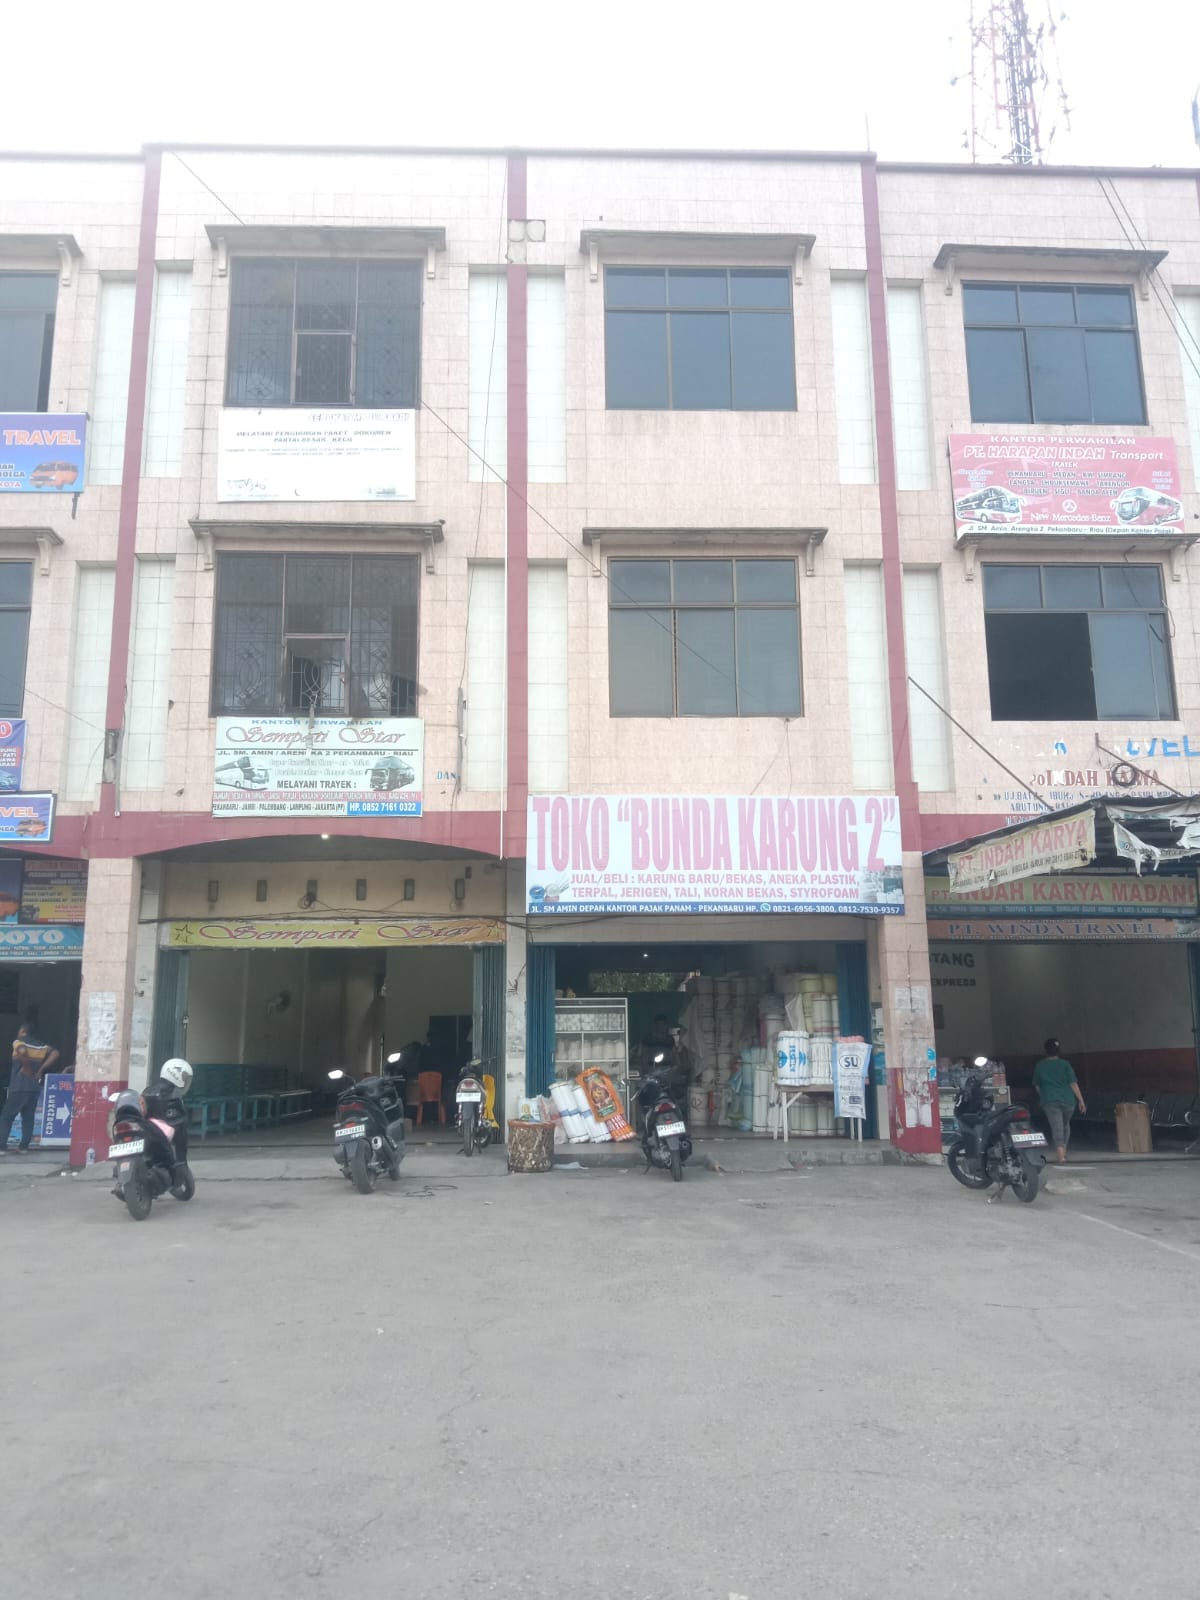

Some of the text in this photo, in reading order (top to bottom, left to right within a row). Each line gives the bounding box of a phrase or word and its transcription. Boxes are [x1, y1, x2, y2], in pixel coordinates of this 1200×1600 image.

[3, 429, 81, 446] TRAVEL
[990, 435, 1136, 445] KANTOR PERWAKILAN
[963, 445, 1164, 462] PT. HARAPAN INDAH Transport
[338, 726, 407, 744] Star
[277, 780, 318, 789] MELAYANI
[319, 780, 352, 789] TRAYEK
[349, 802, 361, 812] HP.
[362, 802, 379, 812] 0852
[381, 802, 398, 812] 7161
[399, 802, 417, 812] 0322
[532, 796, 611, 872] TOKO
[617, 797, 733, 872] "BUNDA
[737, 797, 860, 873] KARUNG
[980, 837, 1026, 872] INDAH
[1030, 818, 1089, 852] KARYA
[570, 873, 629, 885] JUAL/BELI
[637, 873, 686, 885] KARUNG
[688, 873, 766, 887] BARU/BEKAS,
[769, 873, 808, 885] ANEKA
[810, 874, 860, 886] PLASTIK,
[572, 887, 860, 900] TERPAL, JERIGEN, TALI, KORAN BEKAS, STYROFOAM
[1031, 881, 1105, 902] KARYA
[1111, 880, 1196, 903] MADANI
[556, 904, 578, 912] AMIN
[580, 904, 605, 912] DEPAN
[606, 904, 637, 912] KANTOR
[639, 904, 663, 912] PAJAK
[664, 904, 692, 912] PANAM
[698, 904, 744, 912] PEKANBARU
[745, 905, 759, 913] HP.
[838, 905, 900, 914] 0812-7530-9357
[199, 924, 480, 945] Sempati Star
[987, 923, 1065, 935] WINDA
[1073, 922, 1157, 935] TRAVEL
[843, 1056, 859, 1068] SU
